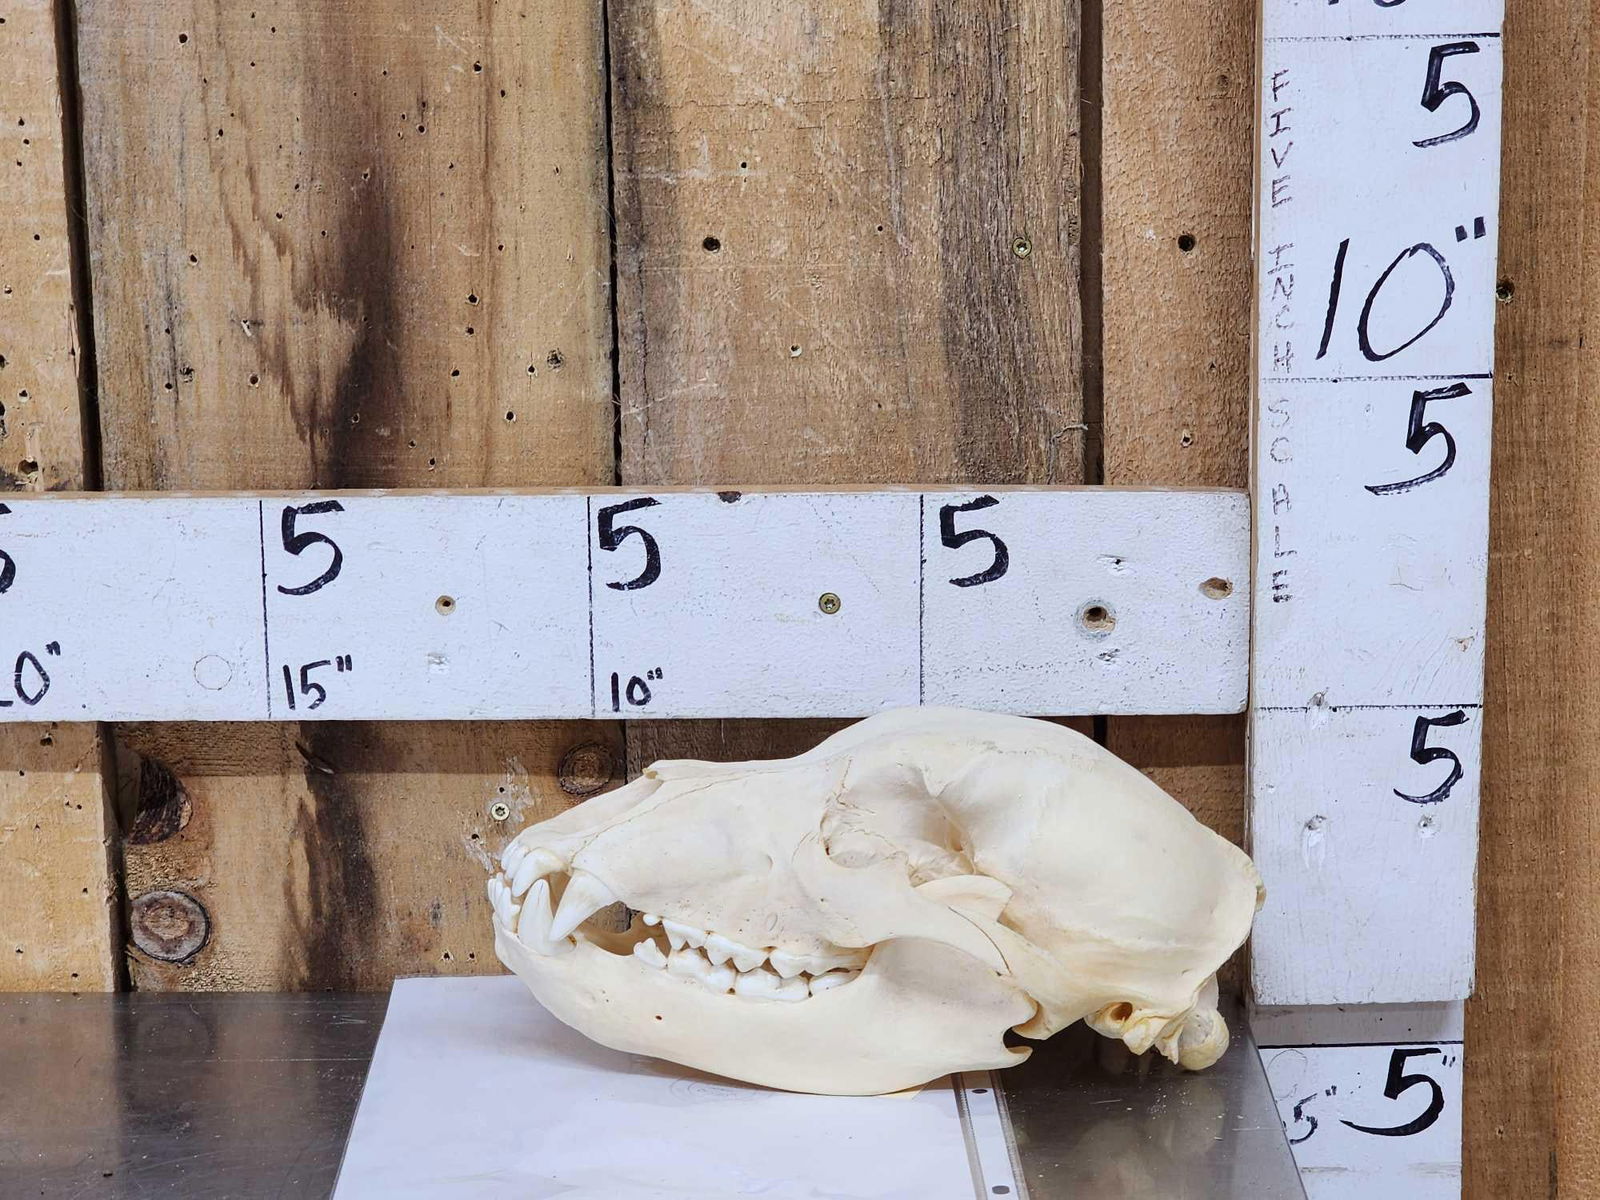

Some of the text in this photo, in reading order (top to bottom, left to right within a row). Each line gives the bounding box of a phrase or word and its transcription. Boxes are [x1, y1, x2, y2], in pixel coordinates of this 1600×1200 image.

[1269, 69, 1293, 208] FIVE
[1412, 41, 1480, 148] 5
[1315, 216, 1486, 362] 10"
[1364, 382, 1472, 496] 5
[277, 500, 345, 596] 5
[597, 497, 662, 591] 5
[939, 494, 1009, 588] 5
[0, 640, 61, 706] 0"
[282, 654, 352, 711] 15"
[610, 667, 664, 713] 10"
[1393, 710, 1470, 806] 5
